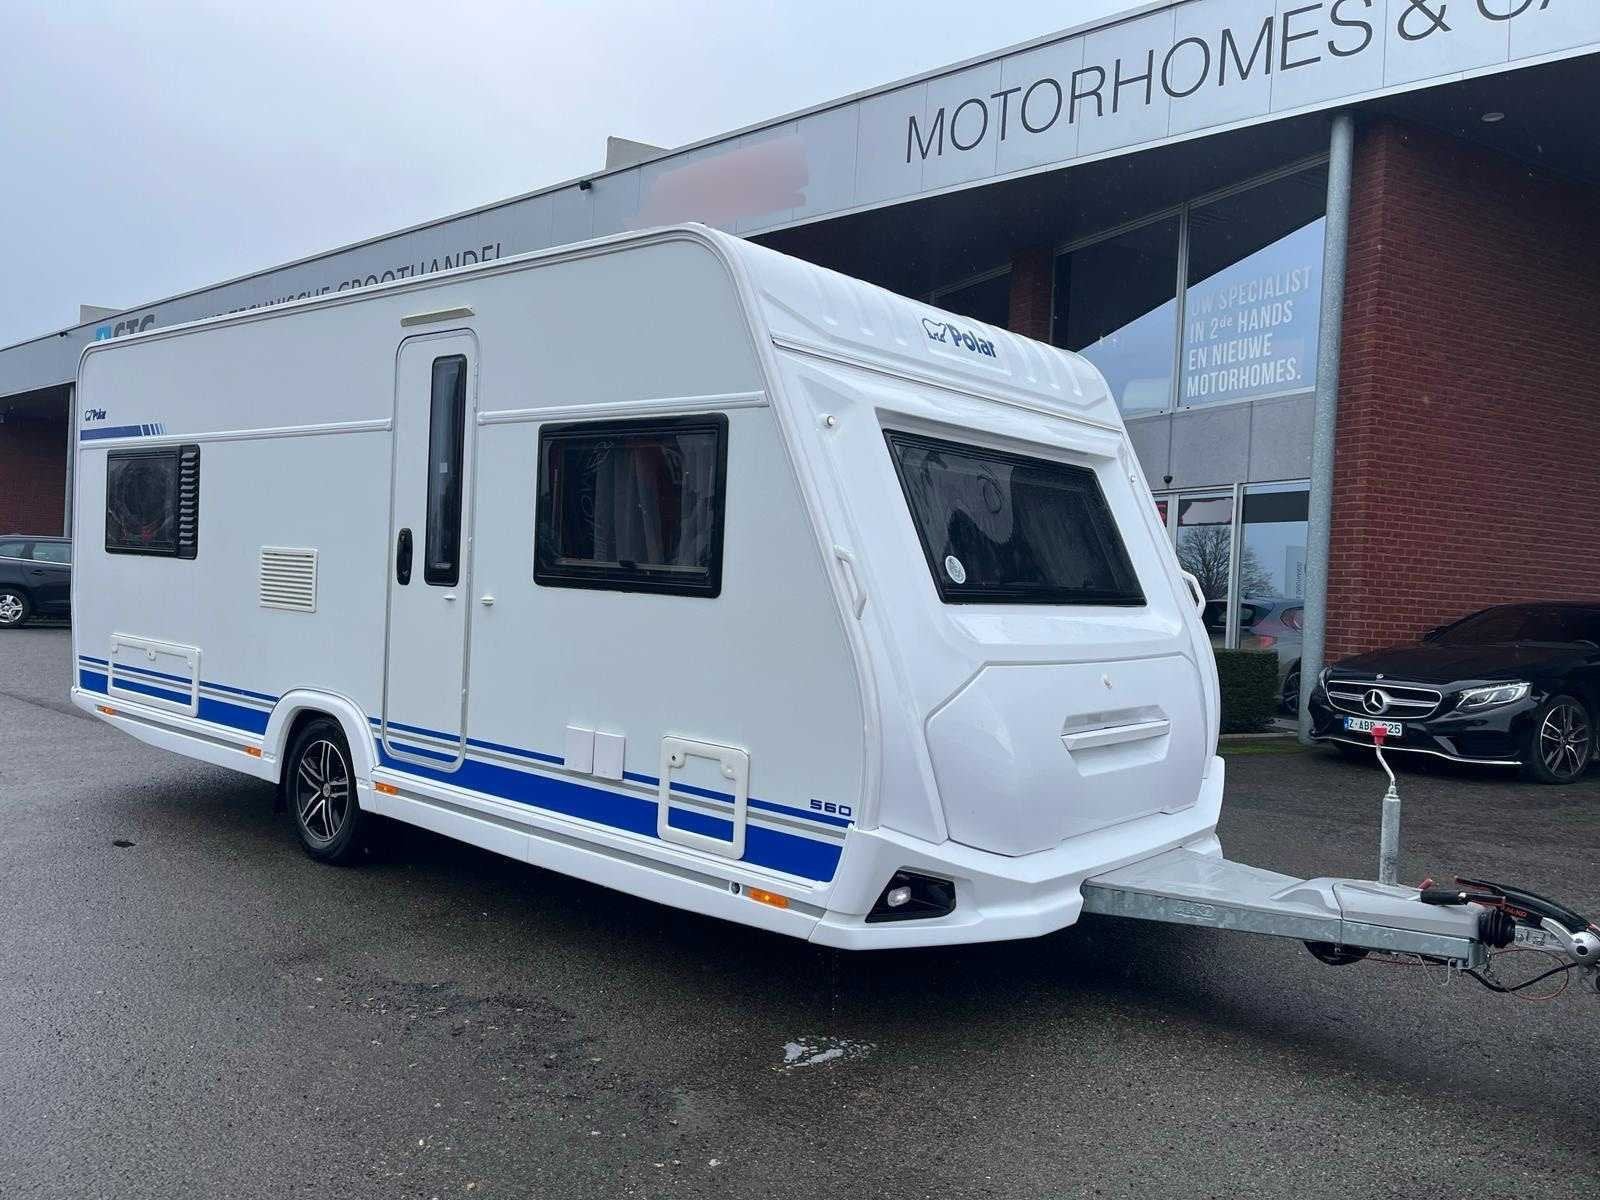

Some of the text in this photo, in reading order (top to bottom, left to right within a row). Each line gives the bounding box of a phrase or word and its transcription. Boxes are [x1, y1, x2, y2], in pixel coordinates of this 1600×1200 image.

[906, 0, 1451, 163] MOTORHOMES &
[1191, 265, 1313, 316] UW SPECIALIST
[946, 322, 997, 358] Polar
[1190, 300, 1294, 343] IN 2de HANDS
[1189, 332, 1273, 371] EN NIEUWE
[1187, 357, 1302, 397] MOTORHOMES.
[809, 798, 852, 817] 560
